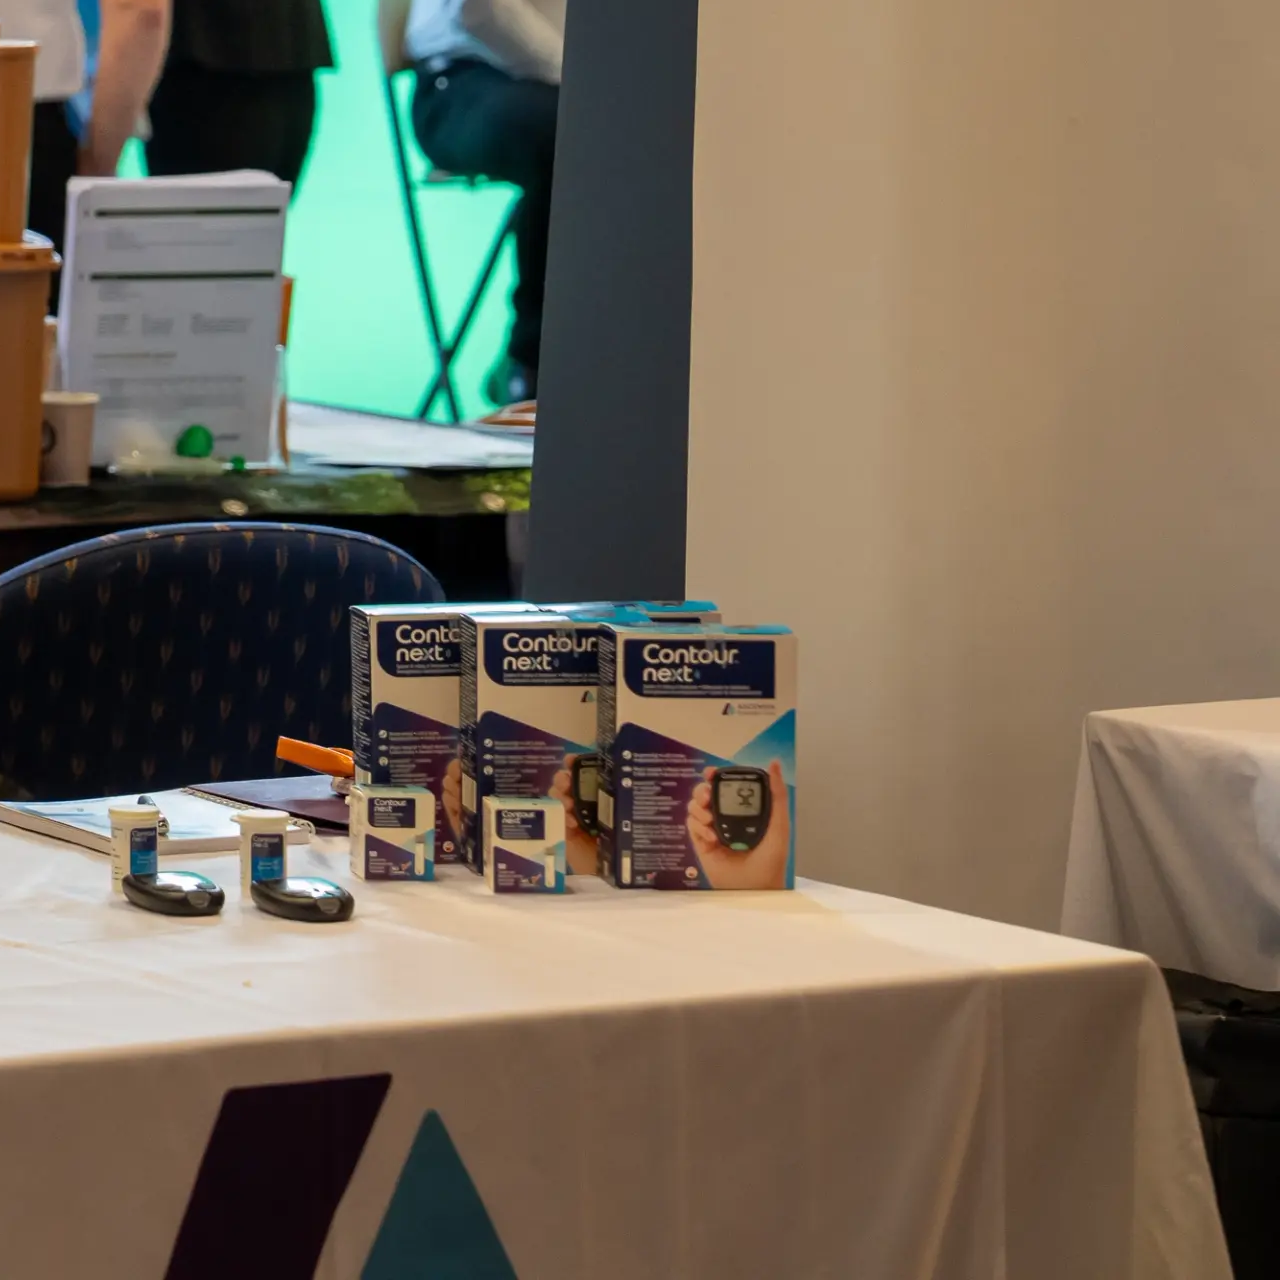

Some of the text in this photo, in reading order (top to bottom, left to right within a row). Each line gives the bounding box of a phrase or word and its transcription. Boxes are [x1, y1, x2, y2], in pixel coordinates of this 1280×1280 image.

[502, 632, 597, 653] Contour
[395, 647, 445, 662] next
[642, 643, 739, 664] Contour
[502, 654, 552, 670] next
[642, 666, 694, 682] next
